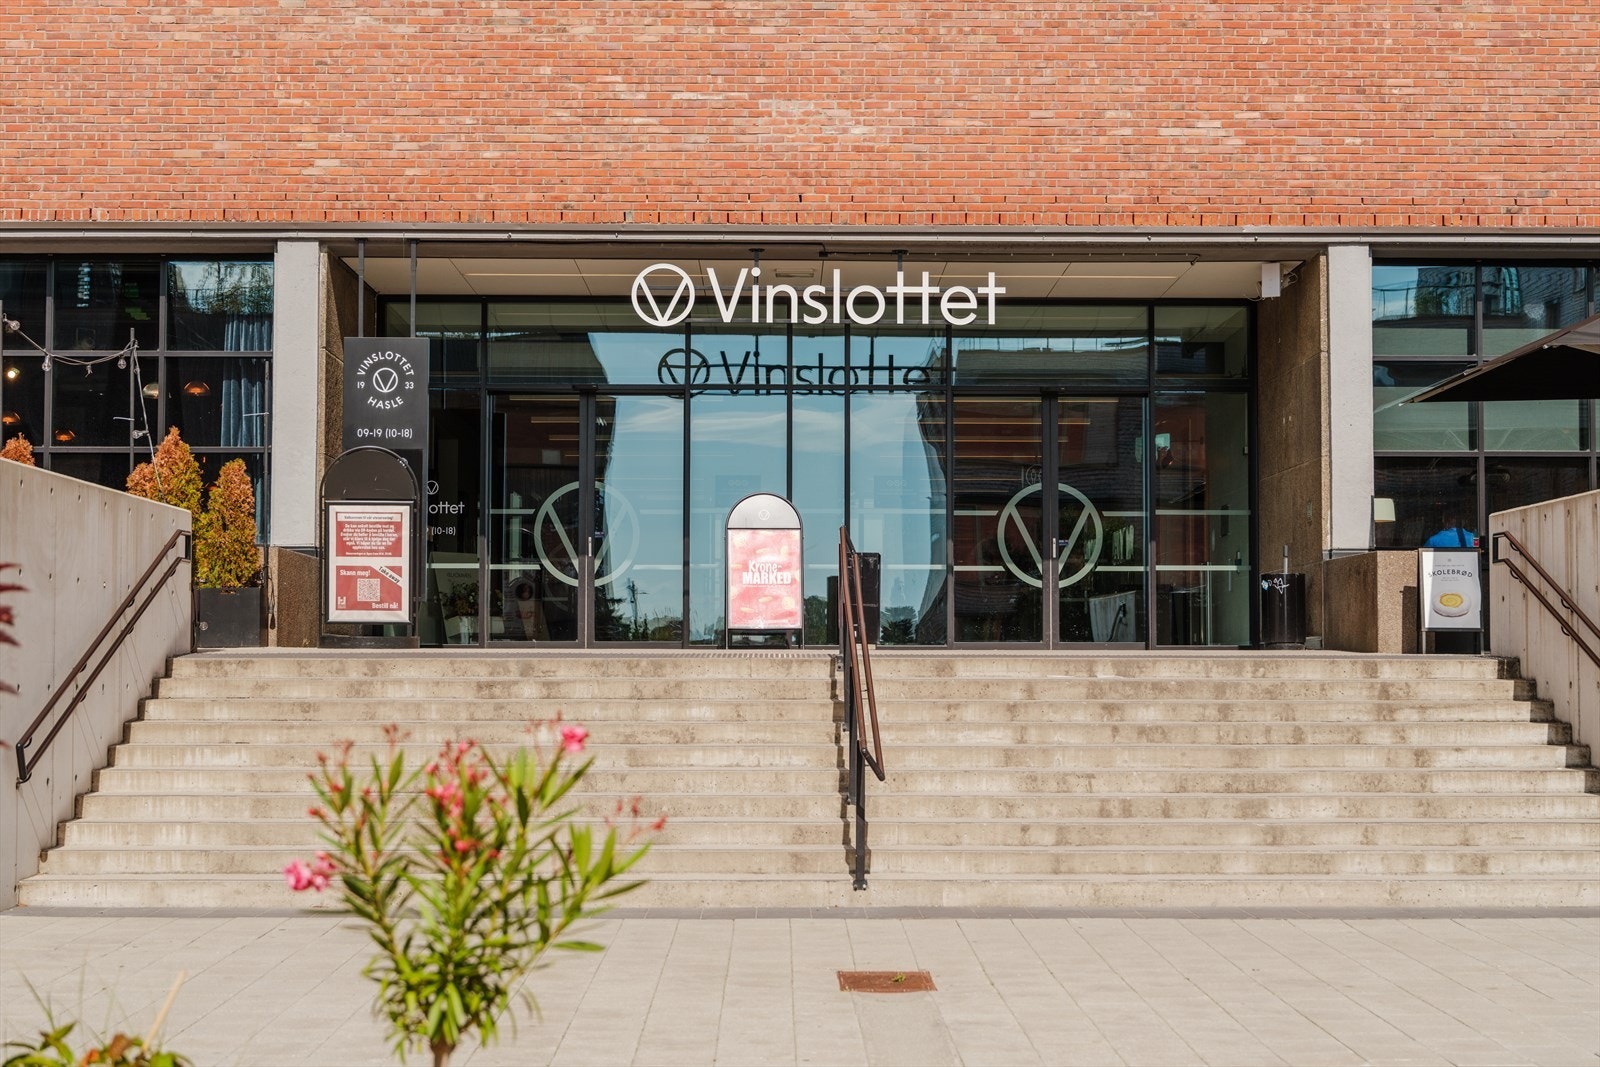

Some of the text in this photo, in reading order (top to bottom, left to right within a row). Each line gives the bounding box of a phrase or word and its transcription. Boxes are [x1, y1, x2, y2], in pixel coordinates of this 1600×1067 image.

[706, 266, 1006, 326] Vinslottet
[357, 351, 415, 376] VINSLOTTET
[357, 381, 415, 390] 19 33
[367, 396, 404, 410] HASLE
[357, 428, 413, 439] 09-19 (10-18)
[742, 570, 792, 585] MARKED
